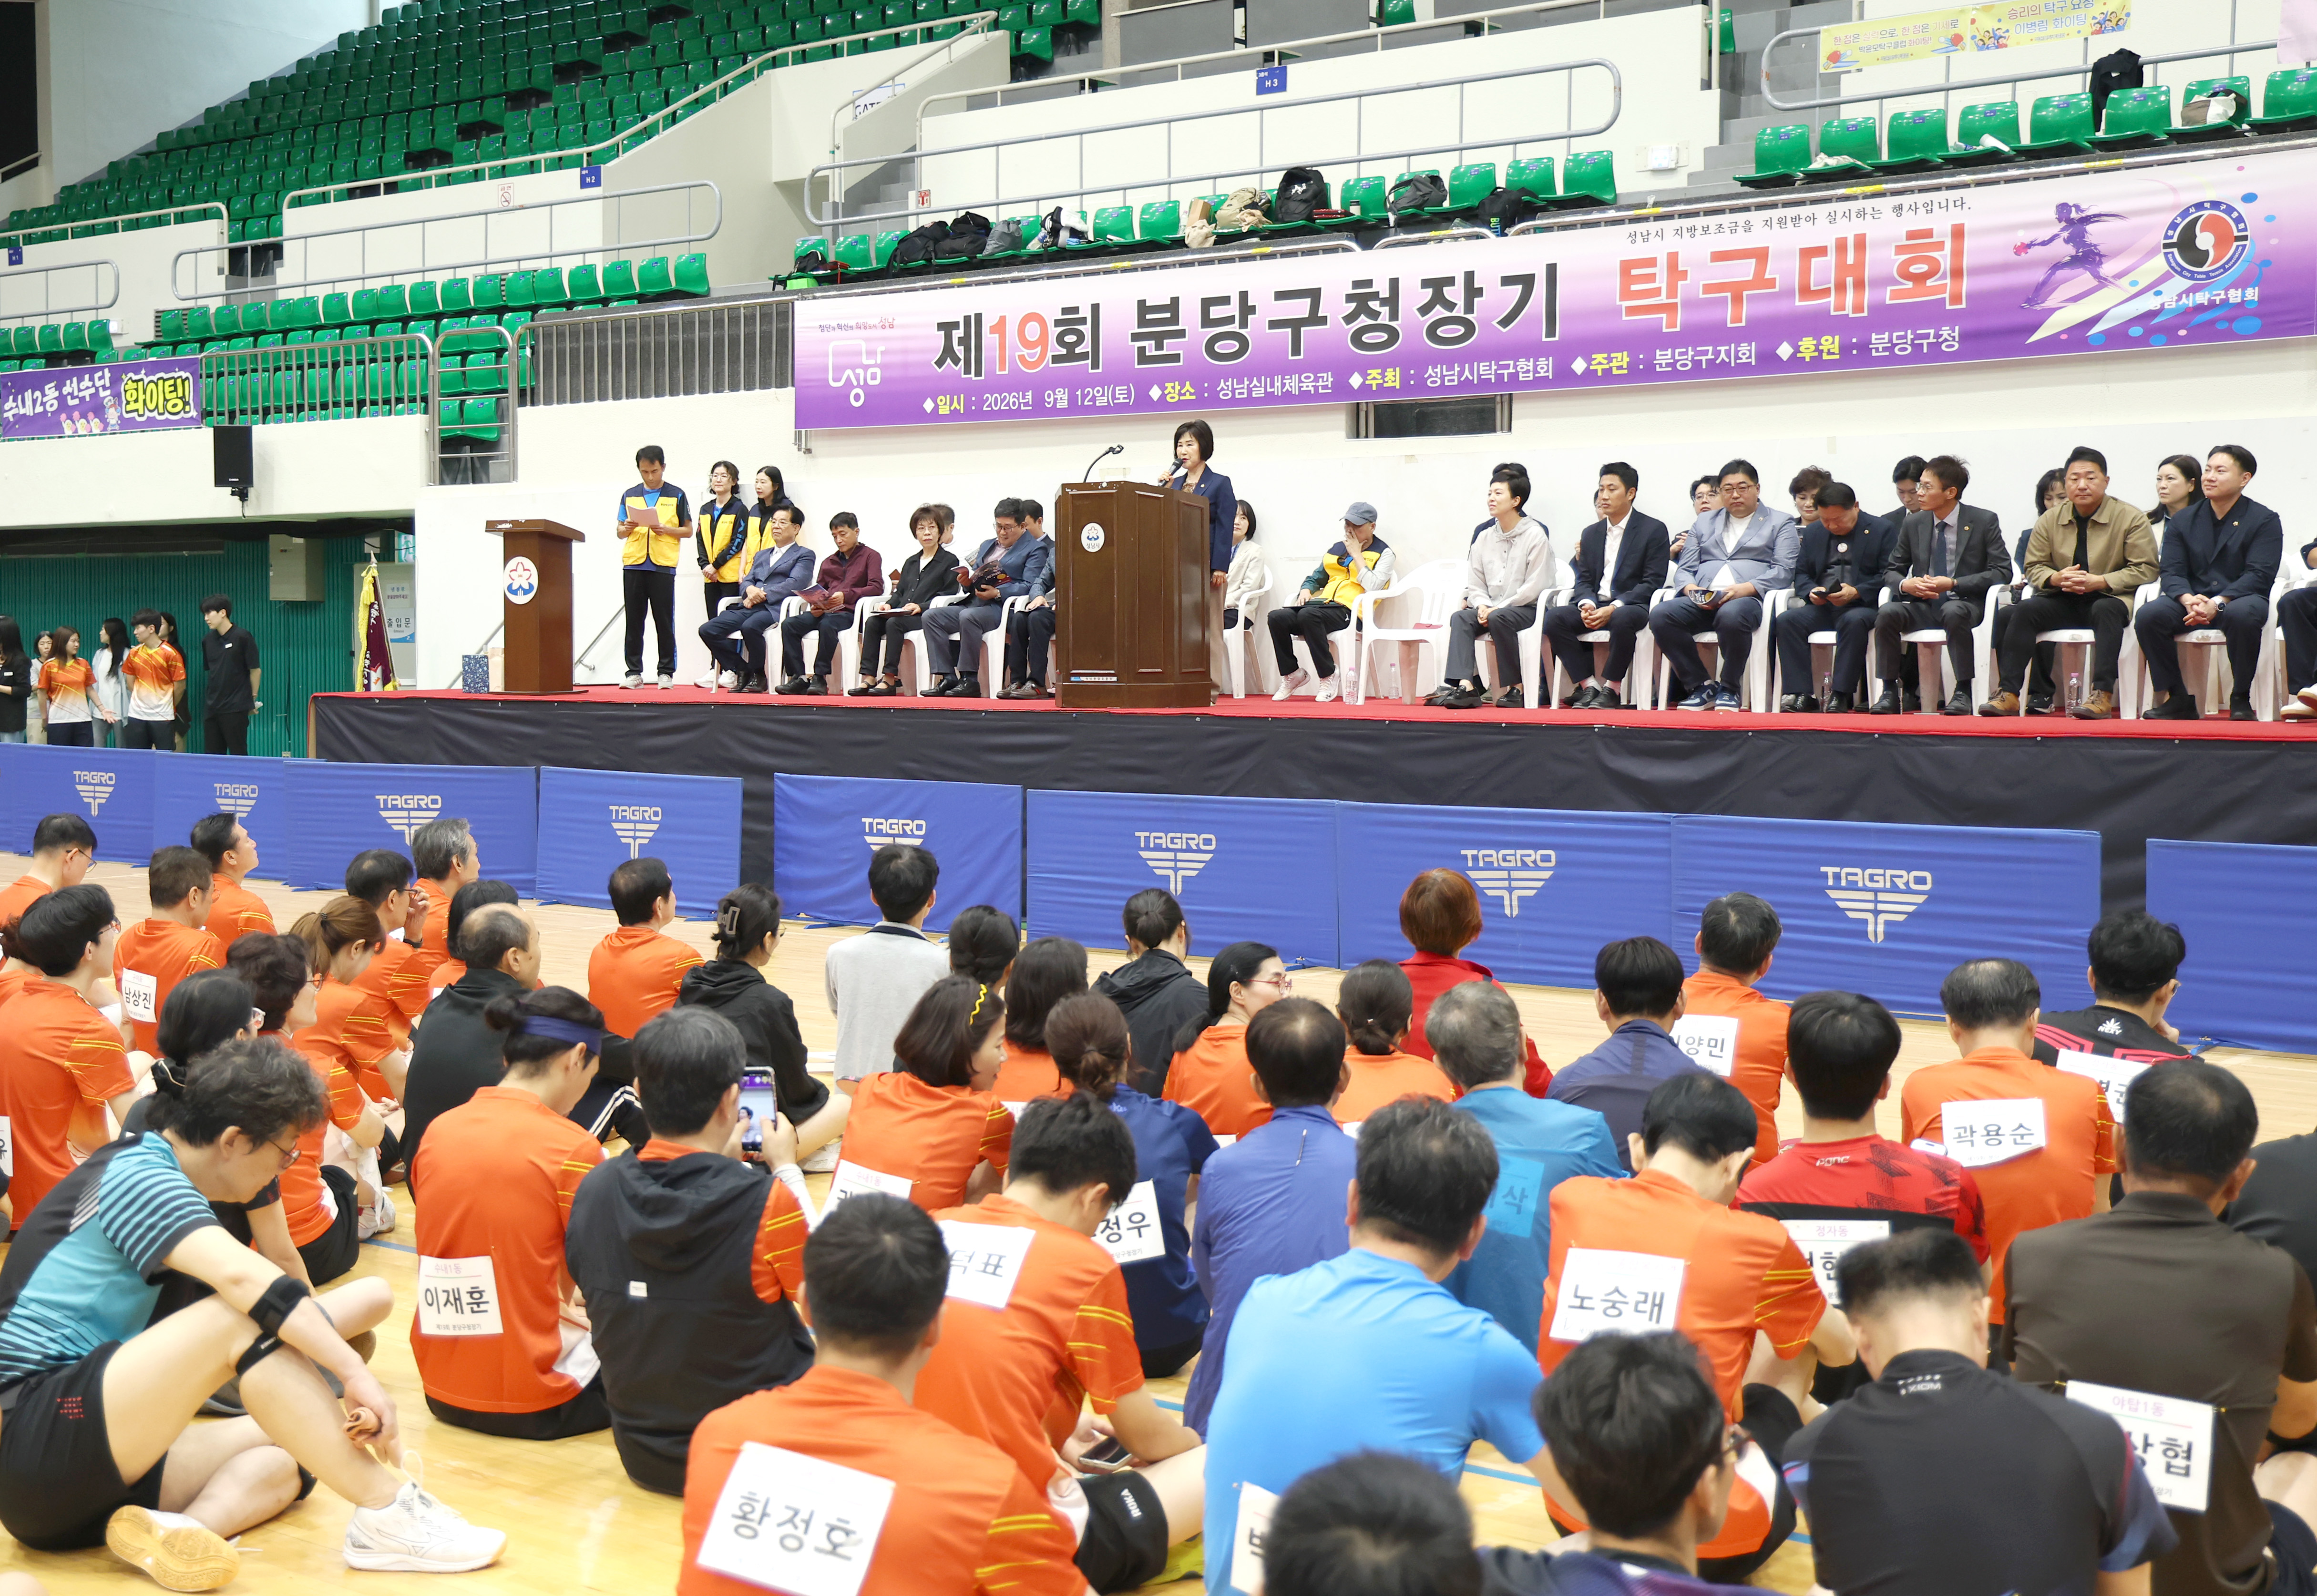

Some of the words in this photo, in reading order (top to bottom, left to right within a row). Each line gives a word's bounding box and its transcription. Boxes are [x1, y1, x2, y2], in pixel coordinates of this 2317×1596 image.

[2007, 4, 2041, 20] 승리의
[2044, 0, 2068, 13] 탁구
[1833, 36, 1842, 46] 한
[1844, 33, 1860, 44] 점은
[1902, 26, 1910, 36] 한
[1912, 23, 1930, 35] 점은
[1933, 19, 1959, 31] 기세로
[2015, 20, 2048, 34] 이병림
[2052, 13, 2087, 29] 화이팅
[1908, 36, 1932, 47] 화이팅!
[1626, 227, 1664, 244] 성남시
[1672, 220, 1754, 239] 지방보조금을
[1762, 213, 1817, 231] 지원받아
[1825, 206, 1883, 225] 실시하는
[1891, 196, 1972, 217] 행사입니다.
[2209, 268, 2224, 277] Tennis
[2225, 246, 2243, 269] Association
[932, 307, 1103, 380] 제19회
[1128, 260, 1561, 365] 분당구청장기
[1617, 221, 1968, 333] 탁구대회
[2147, 286, 2259, 310] 성남시탁구협회
[878, 317, 895, 329] 성남
[1796, 335, 1840, 361] 후원
[1868, 326, 1960, 357] 분당구청
[1589, 351, 1629, 376] 주관
[1653, 342, 1756, 371] 분당구지회
[1365, 367, 1401, 390] 주최
[1424, 357, 1554, 388] 성남시탁구협회
[2, 381, 60, 421] 수내2동
[63, 368, 111, 404] 선수단
[124, 378, 191, 416] 화이팅!
[1164, 381, 1196, 402] 장소
[1216, 370, 1333, 400] 성남실내체육관
[936, 394, 964, 414] 일시
[983, 390, 1033, 411] 2026년
[1044, 388, 1069, 409] 9월
[1076, 383, 1135, 407] 12일(토)
[73, 770, 115, 784] TAGRO
[214, 783, 258, 798] TAGRO
[375, 795, 441, 809] TAGRO
[609, 806, 662, 821] TAGRO
[862, 818, 926, 836] TAGRO
[1135, 832, 1216, 850] TAGRO
[1461, 849, 1556, 867] TAGRO
[1821, 867, 1932, 891] TAGRO
[125, 986, 151, 1010] 남상진
[2098, 1025, 2122, 1035] NEXY
[1952, 1122, 2035, 1147] 곽용순
[1091, 1211, 1151, 1243] 정우
[1816, 1225, 1848, 1237] 정자동
[435, 1263, 462, 1274] 수내1동
[425, 1286, 490, 1315] 이재훈
[2112, 1396, 2165, 1417] 야탑1동
[731, 1491, 857, 1562] 황정호
